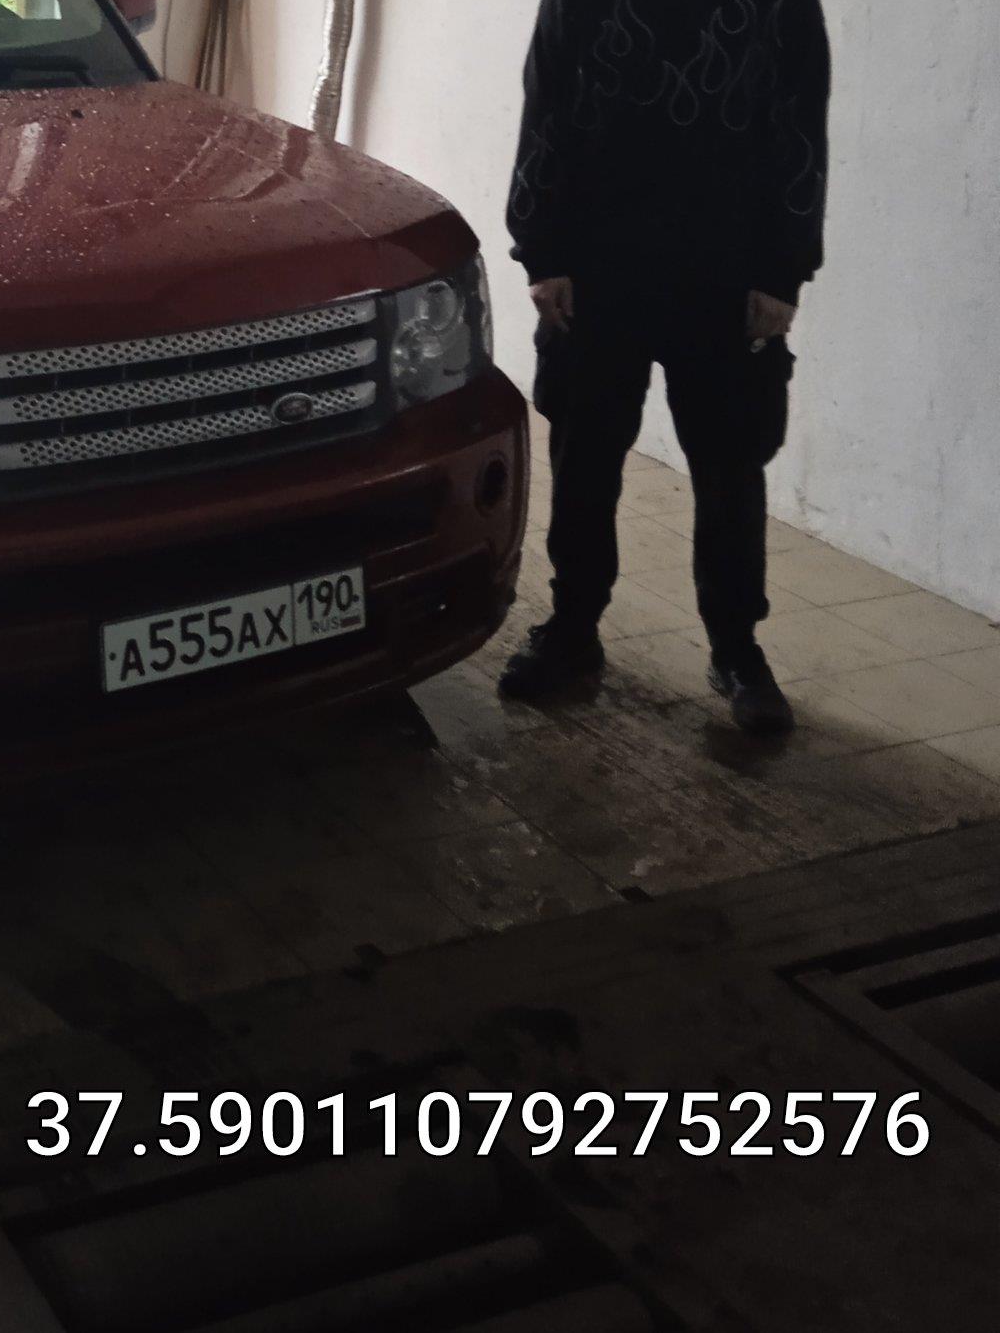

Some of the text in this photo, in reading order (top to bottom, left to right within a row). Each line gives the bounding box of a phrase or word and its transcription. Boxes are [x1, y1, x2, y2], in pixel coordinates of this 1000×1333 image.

[120, 575, 354, 681] А555АХ 190
[312, 616, 339, 635] RUS
